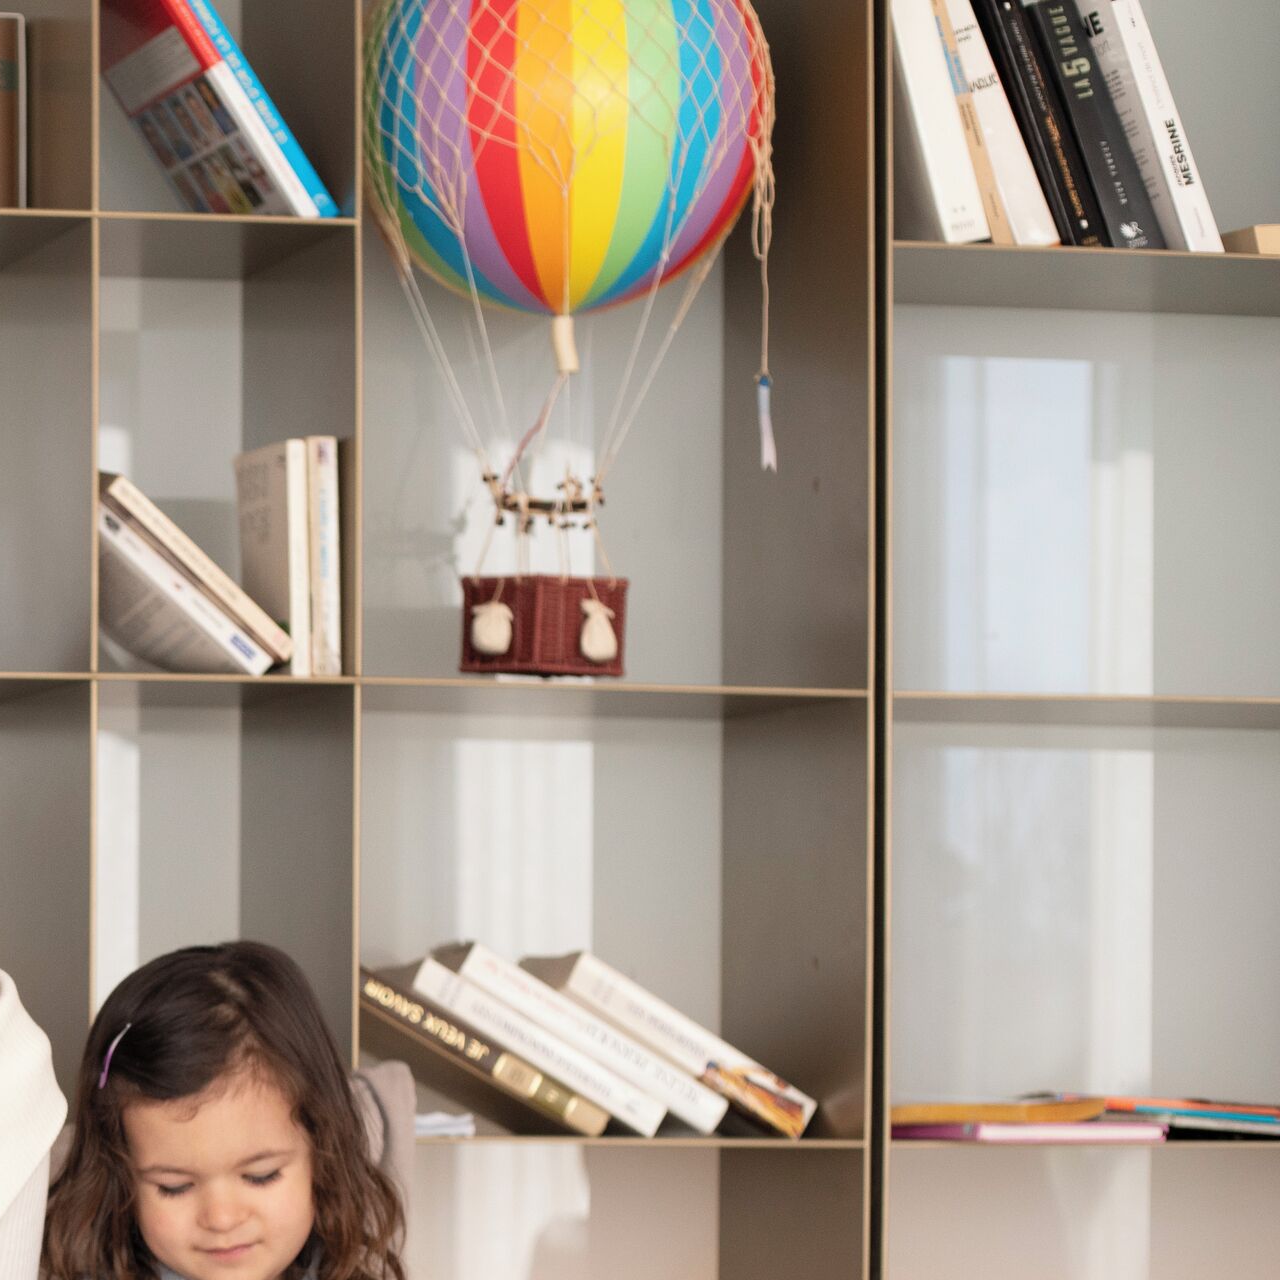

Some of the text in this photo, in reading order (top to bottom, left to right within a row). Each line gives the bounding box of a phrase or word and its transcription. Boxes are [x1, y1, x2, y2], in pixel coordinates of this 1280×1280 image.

[1050, 4, 1078, 57] VAGUE
[1073, 77, 1094, 99] LA
[1164, 118, 1195, 186] MESRINE
[364, 977, 491, 1062] JE VEUX SAVOIR
